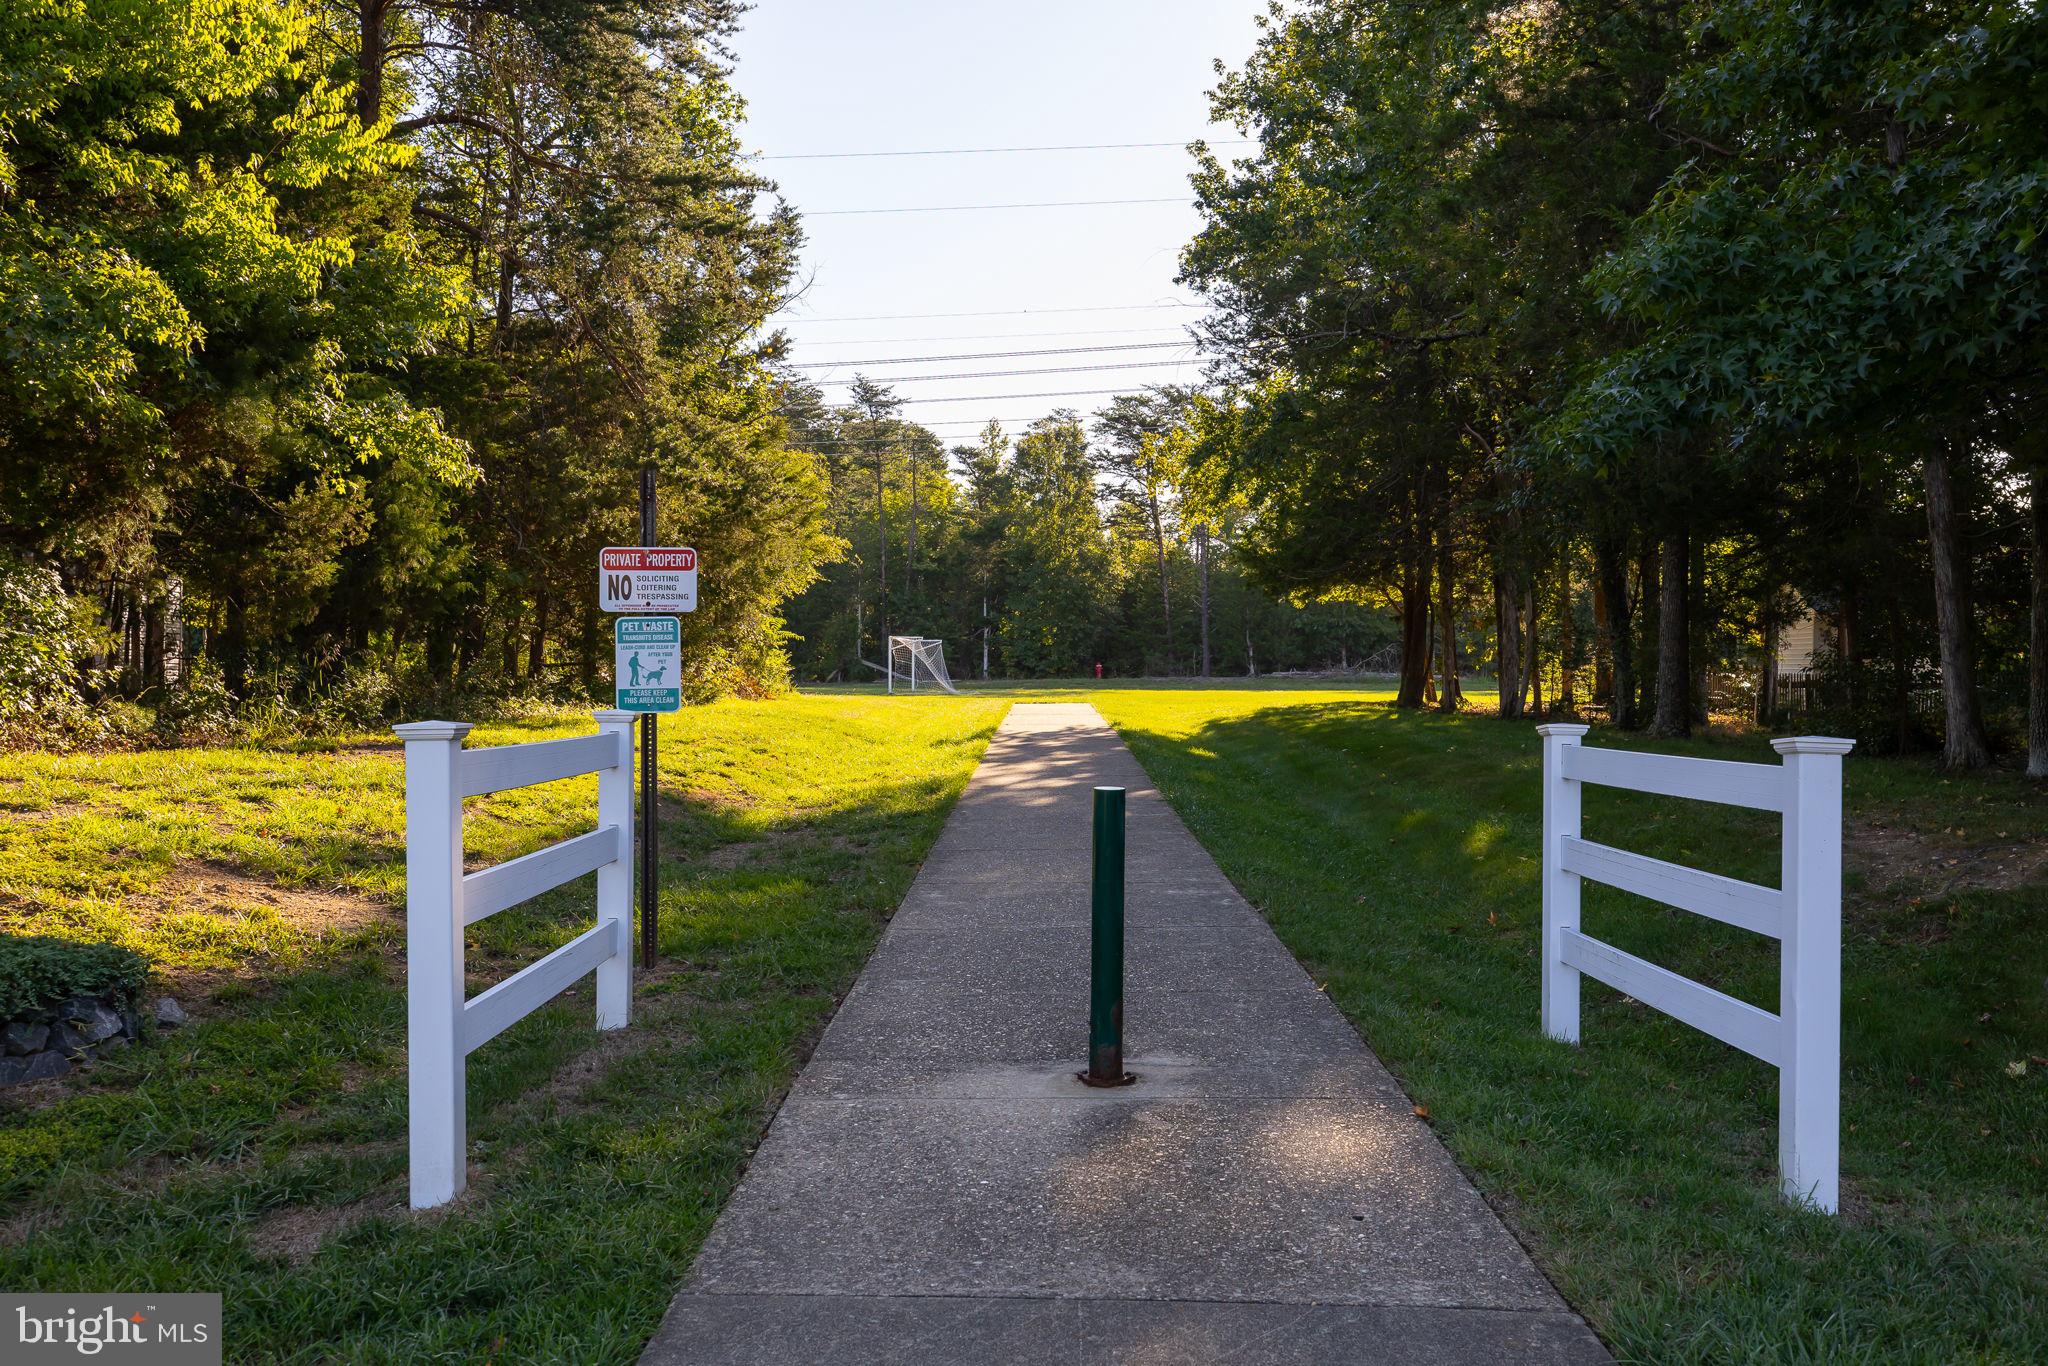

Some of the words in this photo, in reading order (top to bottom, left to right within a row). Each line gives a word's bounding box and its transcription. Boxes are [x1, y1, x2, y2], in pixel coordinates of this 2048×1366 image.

[604, 553, 641, 567] PRIVATE
[646, 553, 693, 567] PROPERTY
[608, 574, 632, 601] NO
[622, 621, 640, 631] PET
[642, 621, 674, 631] WASTE
[629, 689, 651, 697] PLEASE
[639, 696, 655, 704] AREA
